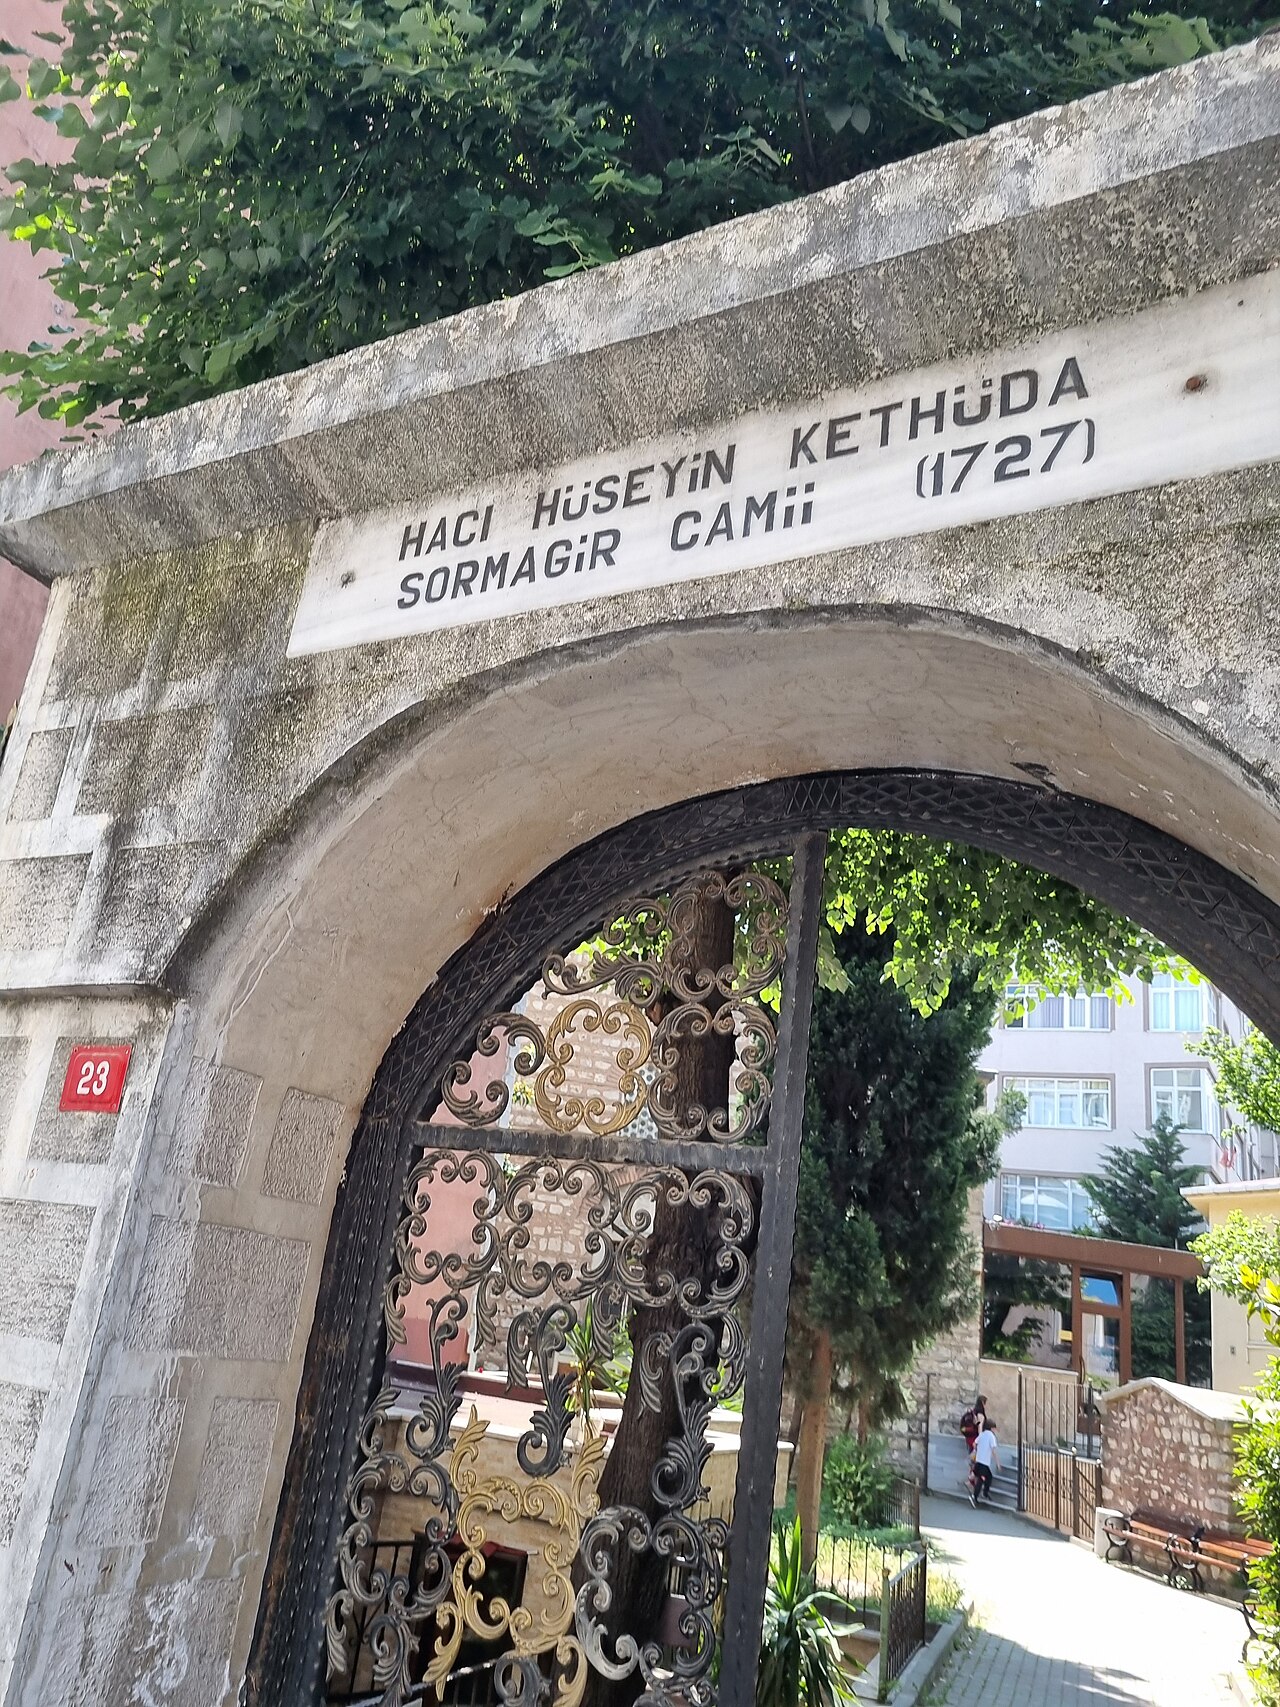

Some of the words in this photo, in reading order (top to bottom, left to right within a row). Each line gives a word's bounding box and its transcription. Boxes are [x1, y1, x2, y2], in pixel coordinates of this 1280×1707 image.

[398, 505, 494, 561] HACI
[532, 445, 736, 530] HÜSEYİN
[789, 357, 1089, 469] KETHÜDA
[398, 529, 621, 609] SORMAGİR
[670, 482, 815, 551] CAMİİ
[915, 418, 1096, 498] (1727)
[76, 1060, 110, 1095] 23
